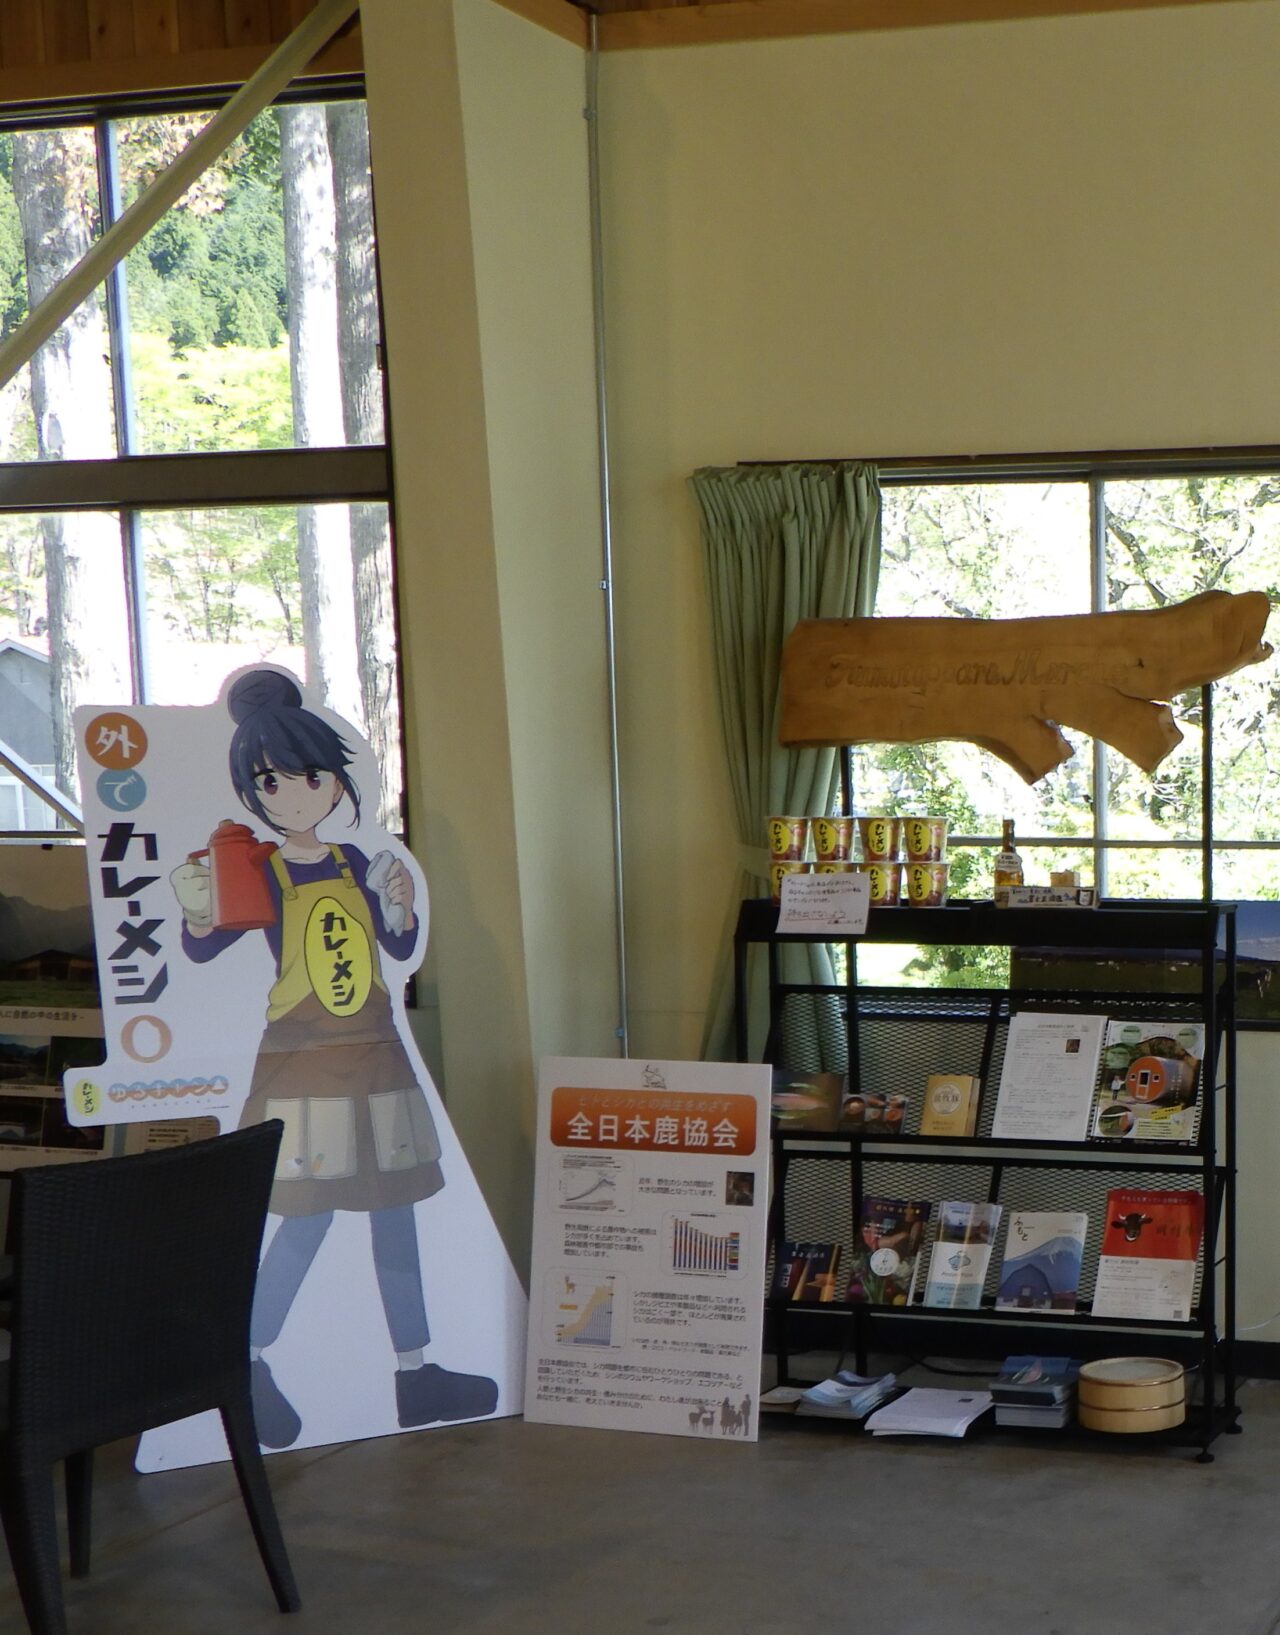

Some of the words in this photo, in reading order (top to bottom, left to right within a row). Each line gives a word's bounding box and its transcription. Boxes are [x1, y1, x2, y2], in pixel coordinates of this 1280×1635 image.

[318, 911, 356, 1008] カレーメシ
[566, 1111, 740, 1149] 全日本鹿協会
